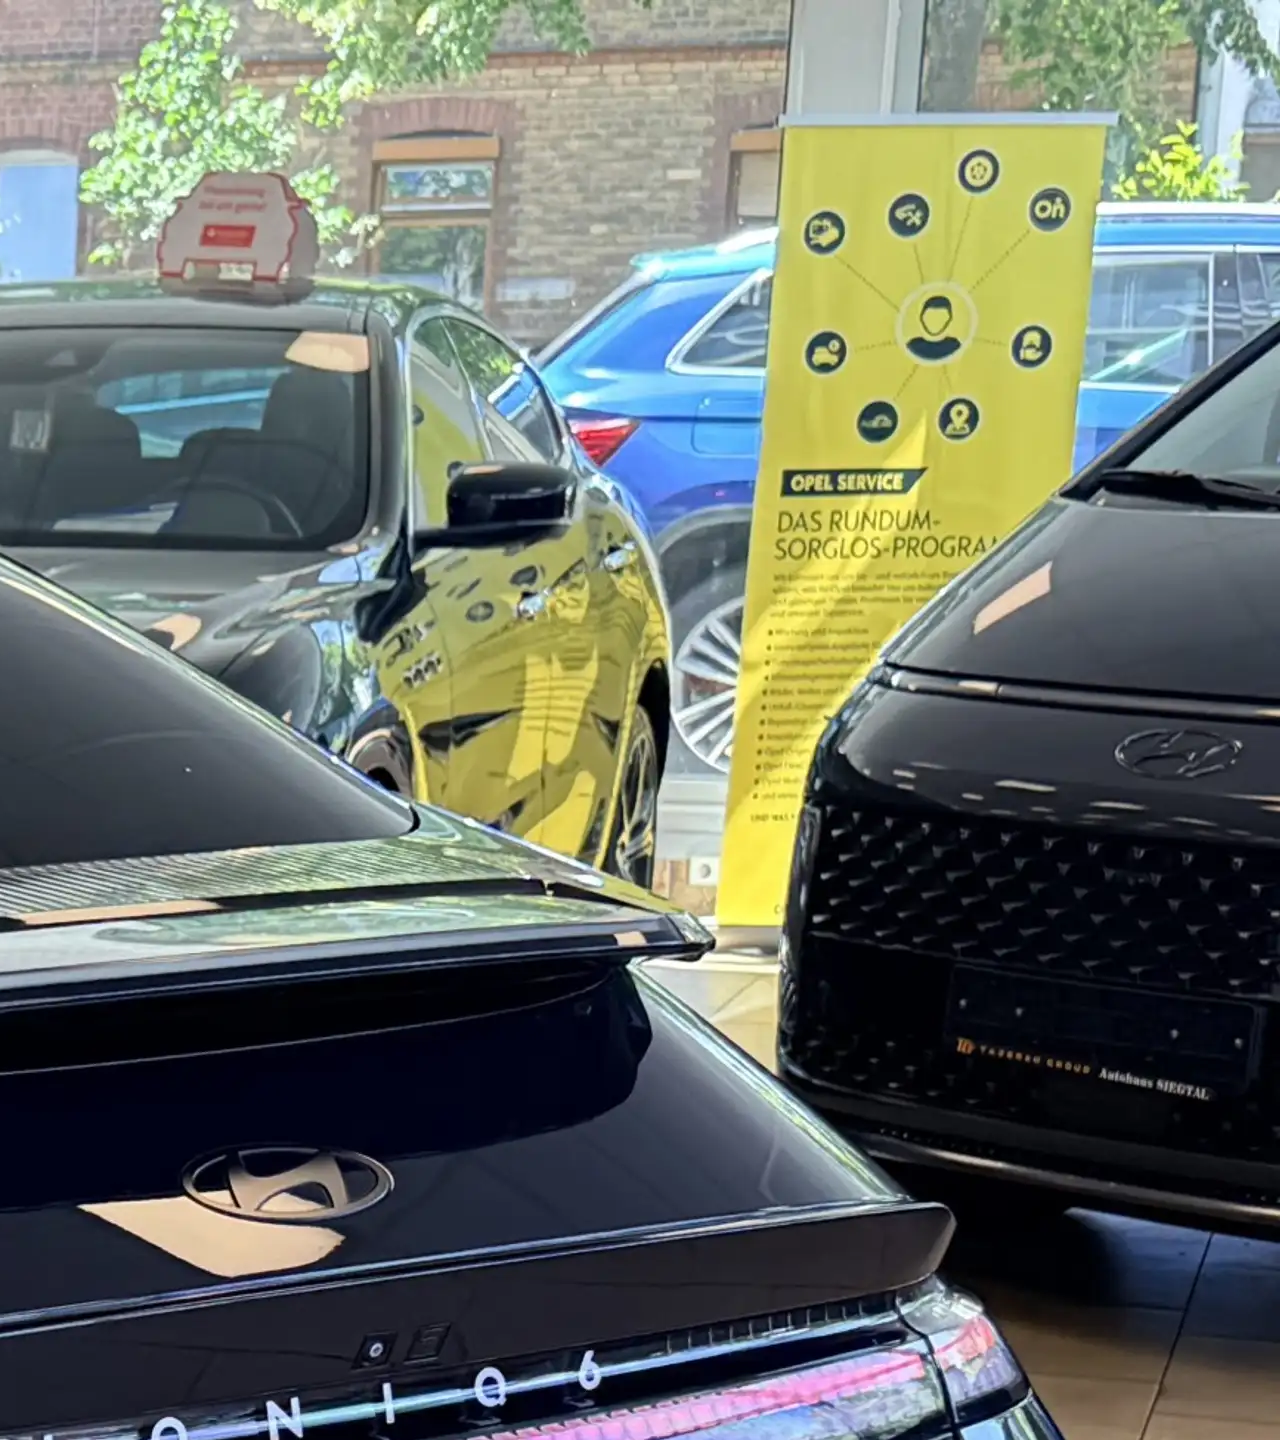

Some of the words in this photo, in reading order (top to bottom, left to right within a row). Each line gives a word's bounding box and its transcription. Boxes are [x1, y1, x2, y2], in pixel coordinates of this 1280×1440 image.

[790, 474, 833, 492] OPEL
[837, 472, 904, 491] SERVICE
[778, 511, 822, 533] DAS
[829, 509, 940, 532] RUNDUM-
[1098, 1067, 1153, 1089] Autohaus
[1156, 1078, 1209, 1101] SIEGTAL
[577, 1349, 603, 1391] 6
